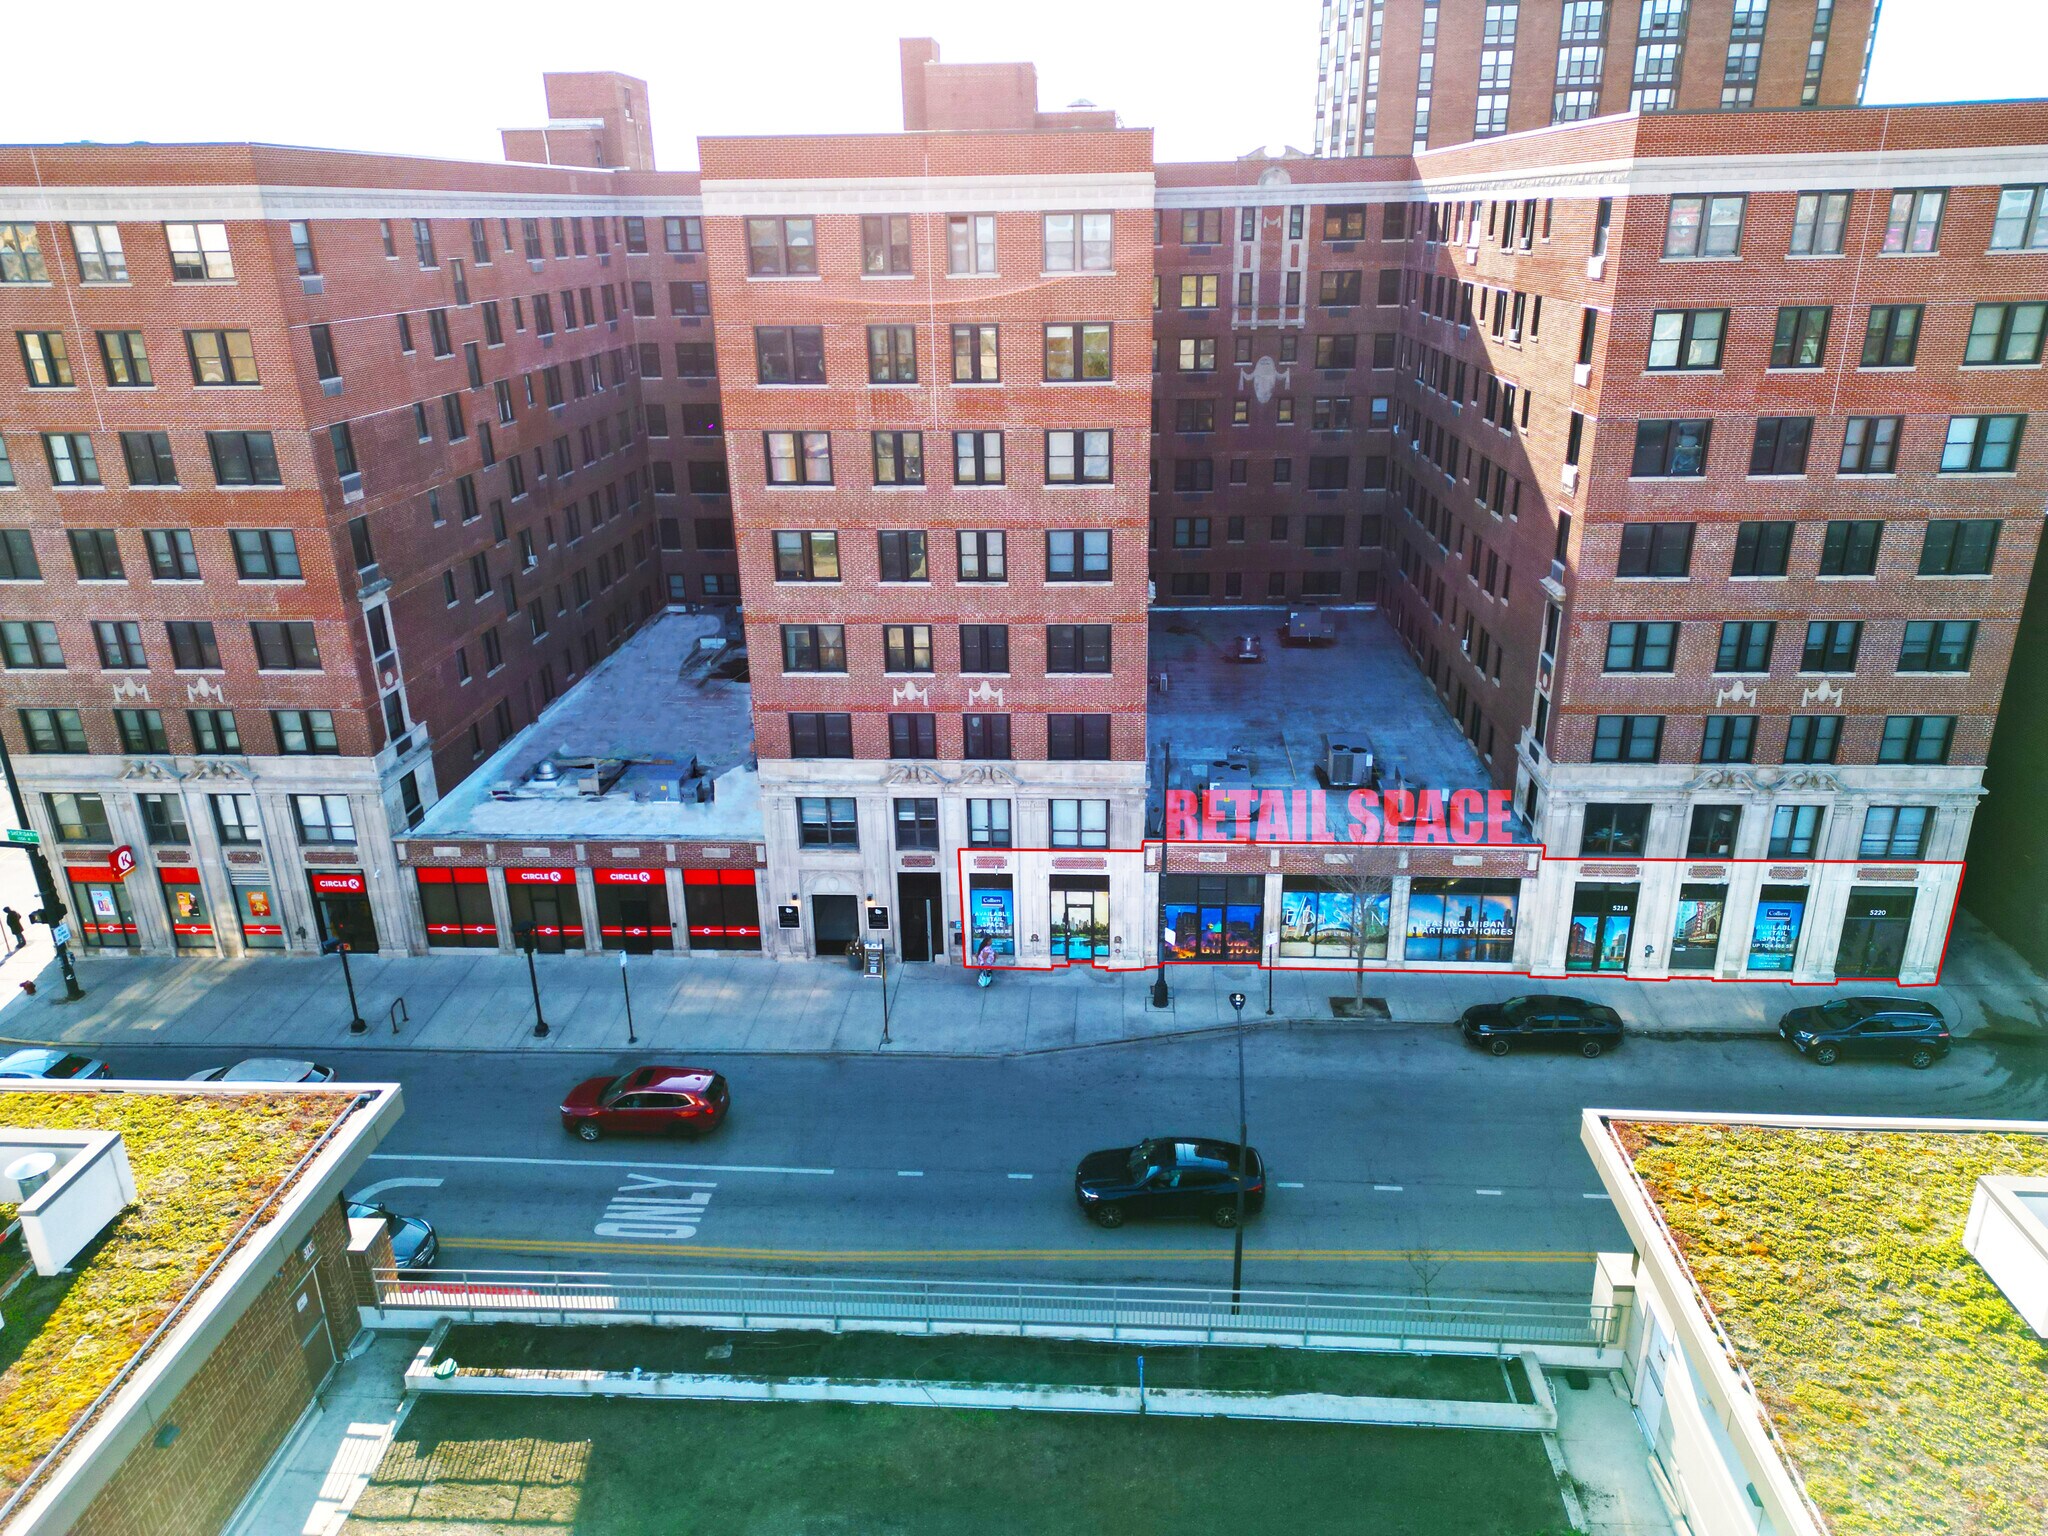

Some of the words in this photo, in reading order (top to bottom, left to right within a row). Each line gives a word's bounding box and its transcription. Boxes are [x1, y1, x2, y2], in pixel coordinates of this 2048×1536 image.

[119, 852, 131, 867] K
[1286, 909, 1384, 926] EDISN
[1420, 920, 1464, 928] LEASING
[1475, 928, 1513, 936] HOMES
[594, 1173, 717, 1239] ONLY
